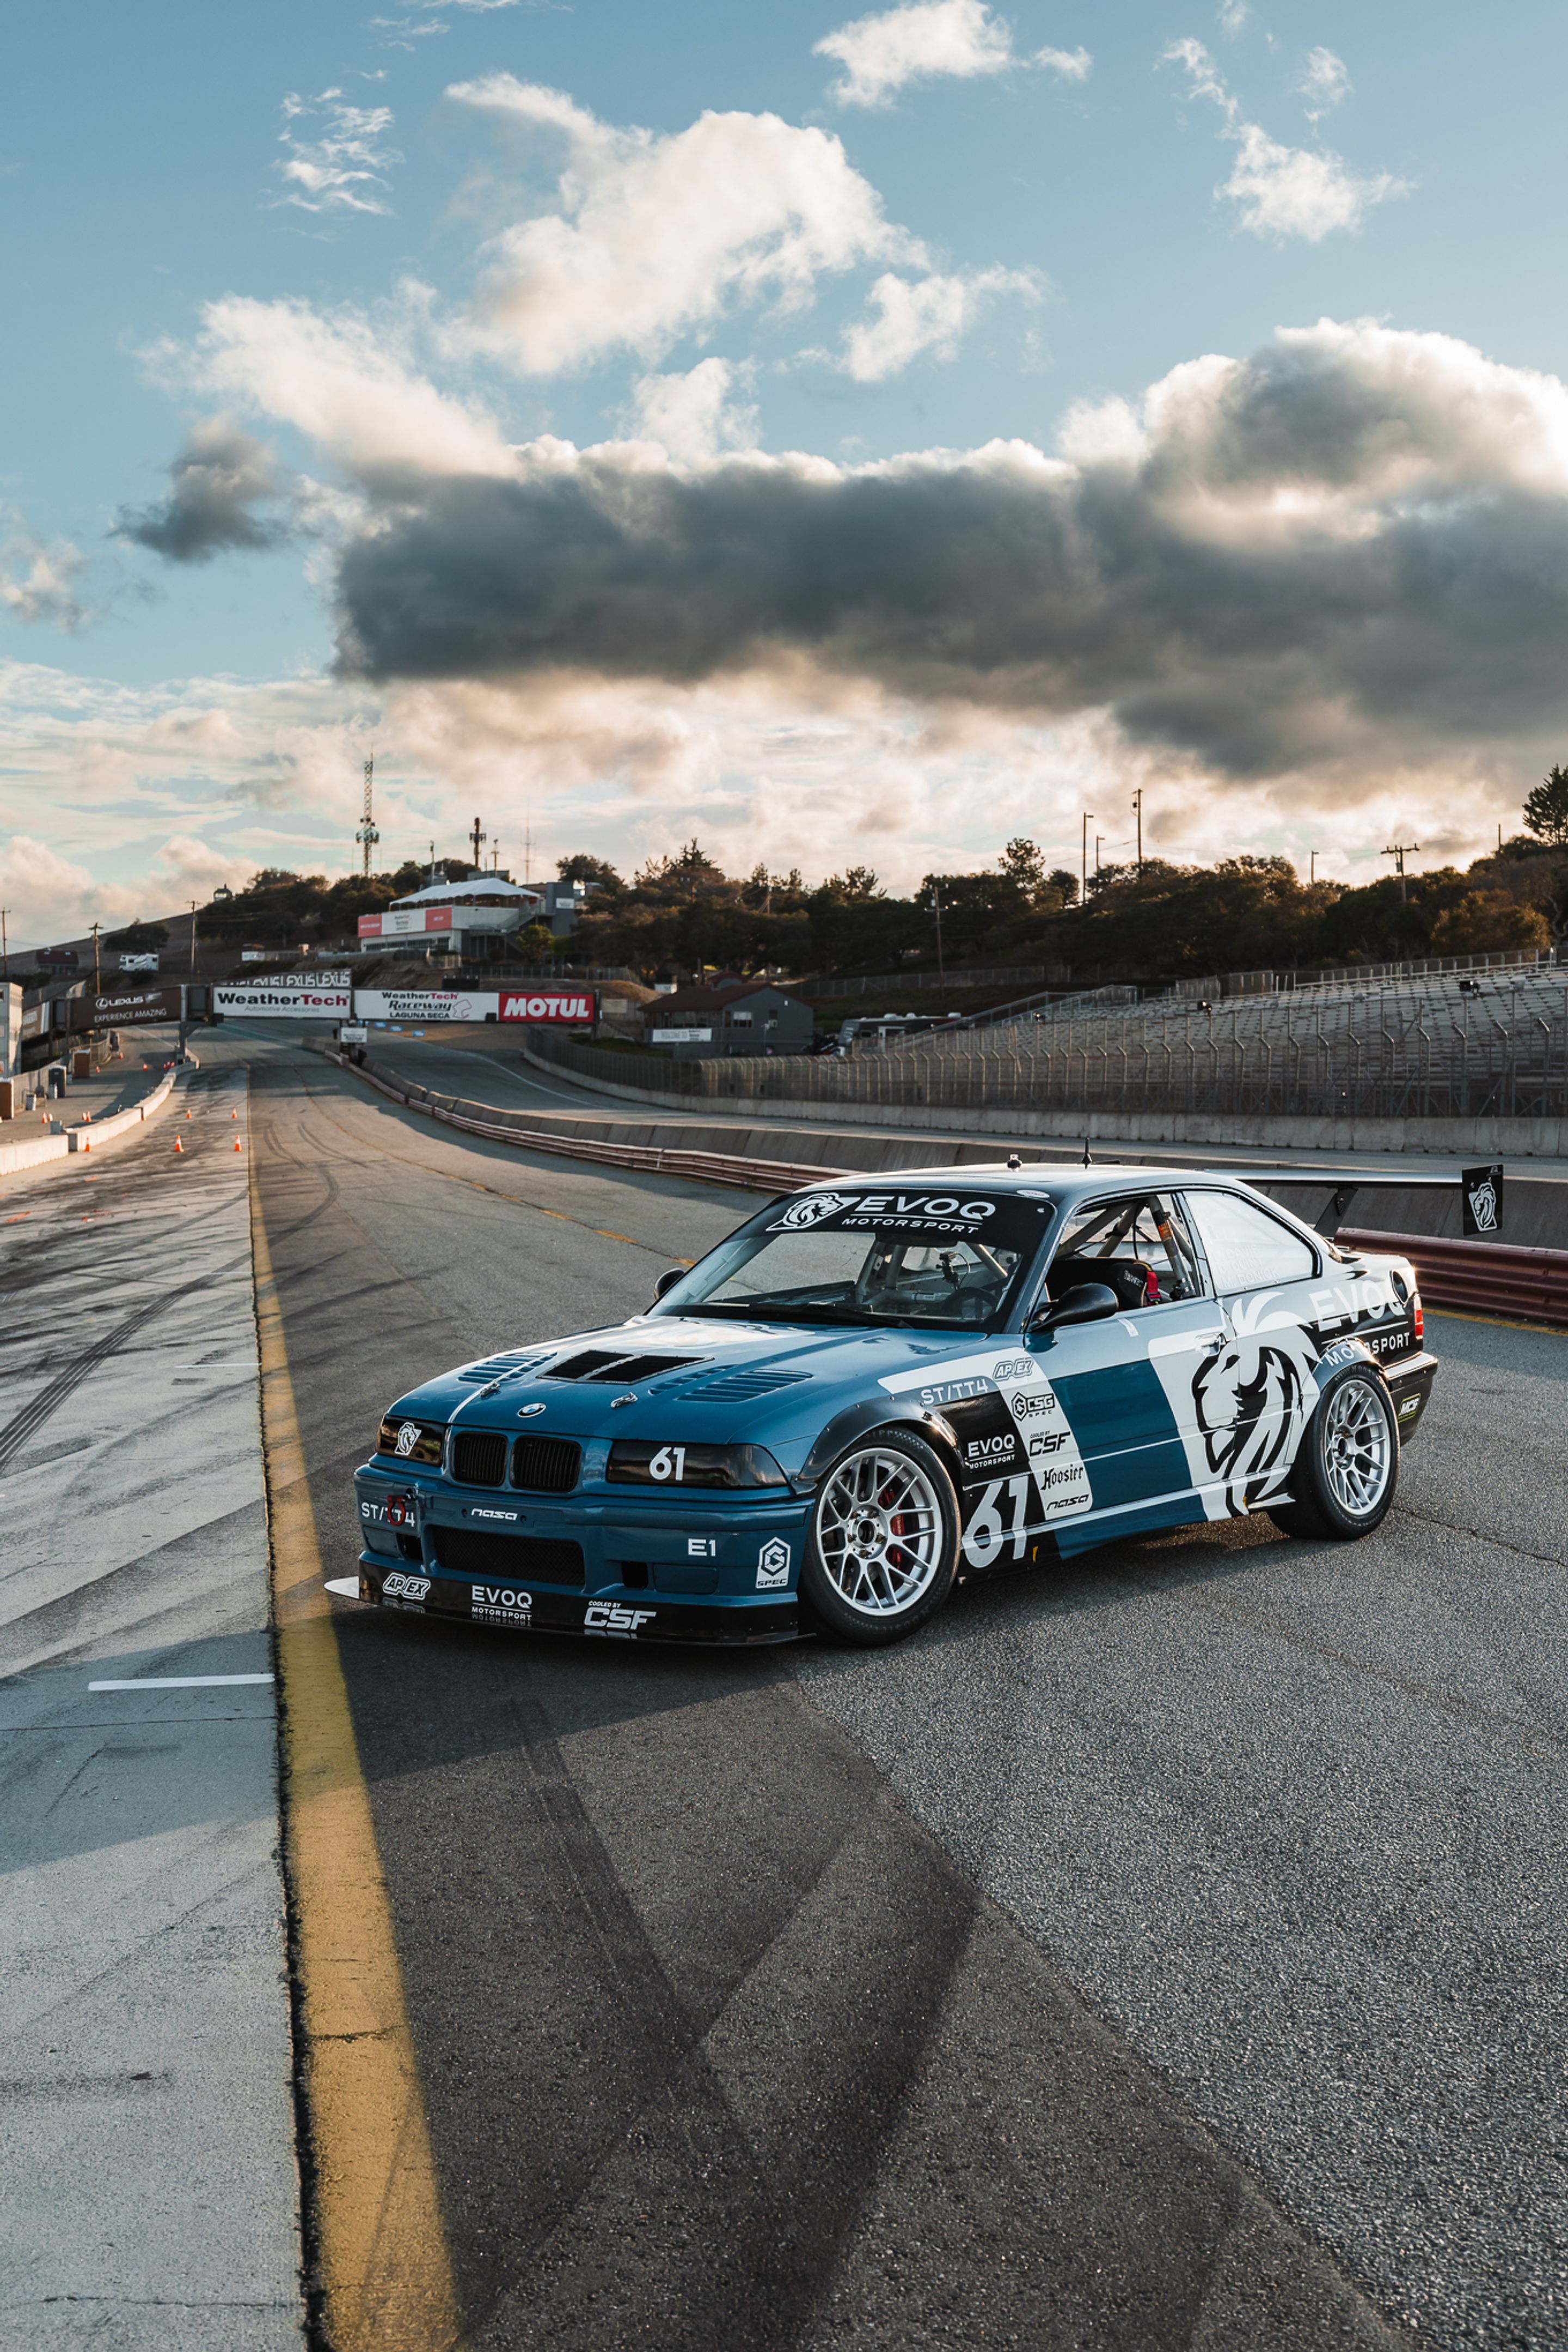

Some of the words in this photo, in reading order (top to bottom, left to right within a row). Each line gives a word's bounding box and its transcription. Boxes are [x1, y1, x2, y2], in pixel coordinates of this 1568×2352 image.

[316, 971, 351, 987] LEXUS
[109, 996, 144, 1006] LEXUS
[218, 993, 347, 1006] WeatherTech
[389, 1000, 452, 1012] Raceway
[504, 997, 590, 1018] MOTUL
[94, 1011, 133, 1023] EXPERIENCE
[134, 1008, 167, 1018] AMAZING
[854, 1196, 996, 1220] EVOQ
[842, 1218, 979, 1234] MOTORSPORT
[921, 1379, 989, 1405] ST/TT4
[1027, 1394, 1055, 1411] CSG
[1028, 1410, 1053, 1418] SPEC
[967, 1434, 1015, 1457] EVOQ
[1030, 1431, 1071, 1457] CSF
[650, 1447, 685, 1481] 61
[969, 1454, 1015, 1469] MOTORSPORT
[1040, 1464, 1083, 1490] Hoosier
[961, 1475, 1028, 1569] 61
[688, 1539, 716, 1557] E1
[757, 1578, 787, 1587] SPEC
[472, 1585, 532, 1609] EVOQ
[472, 1607, 532, 1621] MOTORSPORT
[584, 1607, 657, 1630] CSF
